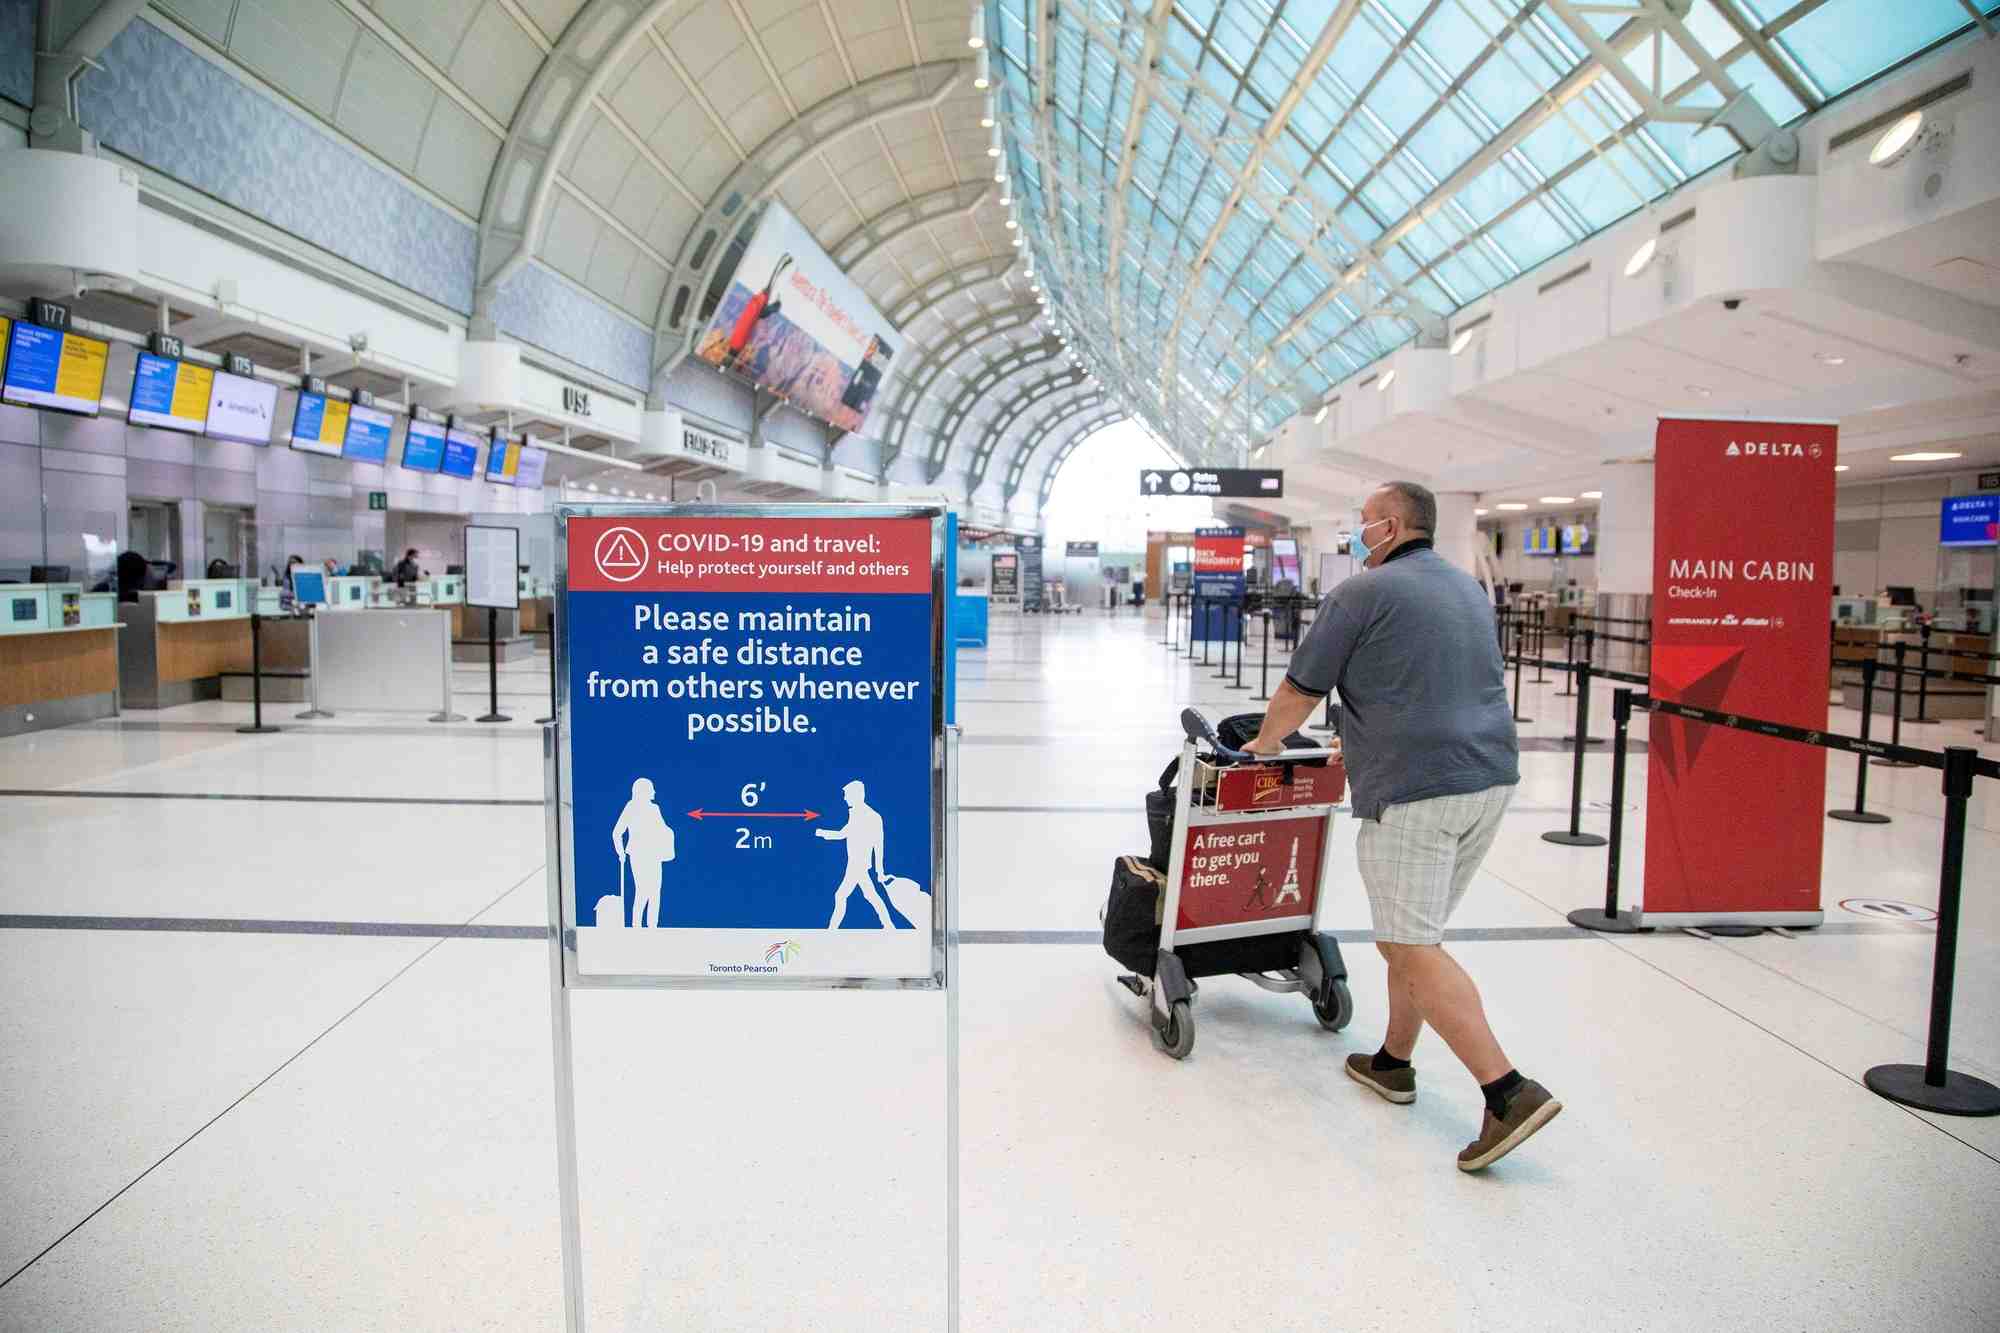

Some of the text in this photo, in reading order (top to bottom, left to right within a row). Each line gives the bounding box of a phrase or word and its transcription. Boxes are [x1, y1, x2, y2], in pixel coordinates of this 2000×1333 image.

[43, 304, 66, 325] 177
[161, 337, 180, 357] 176
[234, 356, 251, 373] 175
[1744, 442, 1804, 457] DELTA
[657, 533, 881, 554] COVID-19 and travel:
[657, 559, 910, 579] Help protect yourself and others
[1670, 559, 1815, 582] MAIN CABIN
[1668, 585, 1717, 599] Check-In
[634, 604, 871, 632] Please maintain
[642, 638, 863, 667] a safe distance
[587, 671, 920, 700] from others whenever
[687, 706, 818, 740] possible.
[1193, 831, 1266, 850] A free cart
[1191, 852, 1260, 872] to get you
[1189, 872, 1231, 888] there.
[709, 963, 778, 974] Toronto Pearson
